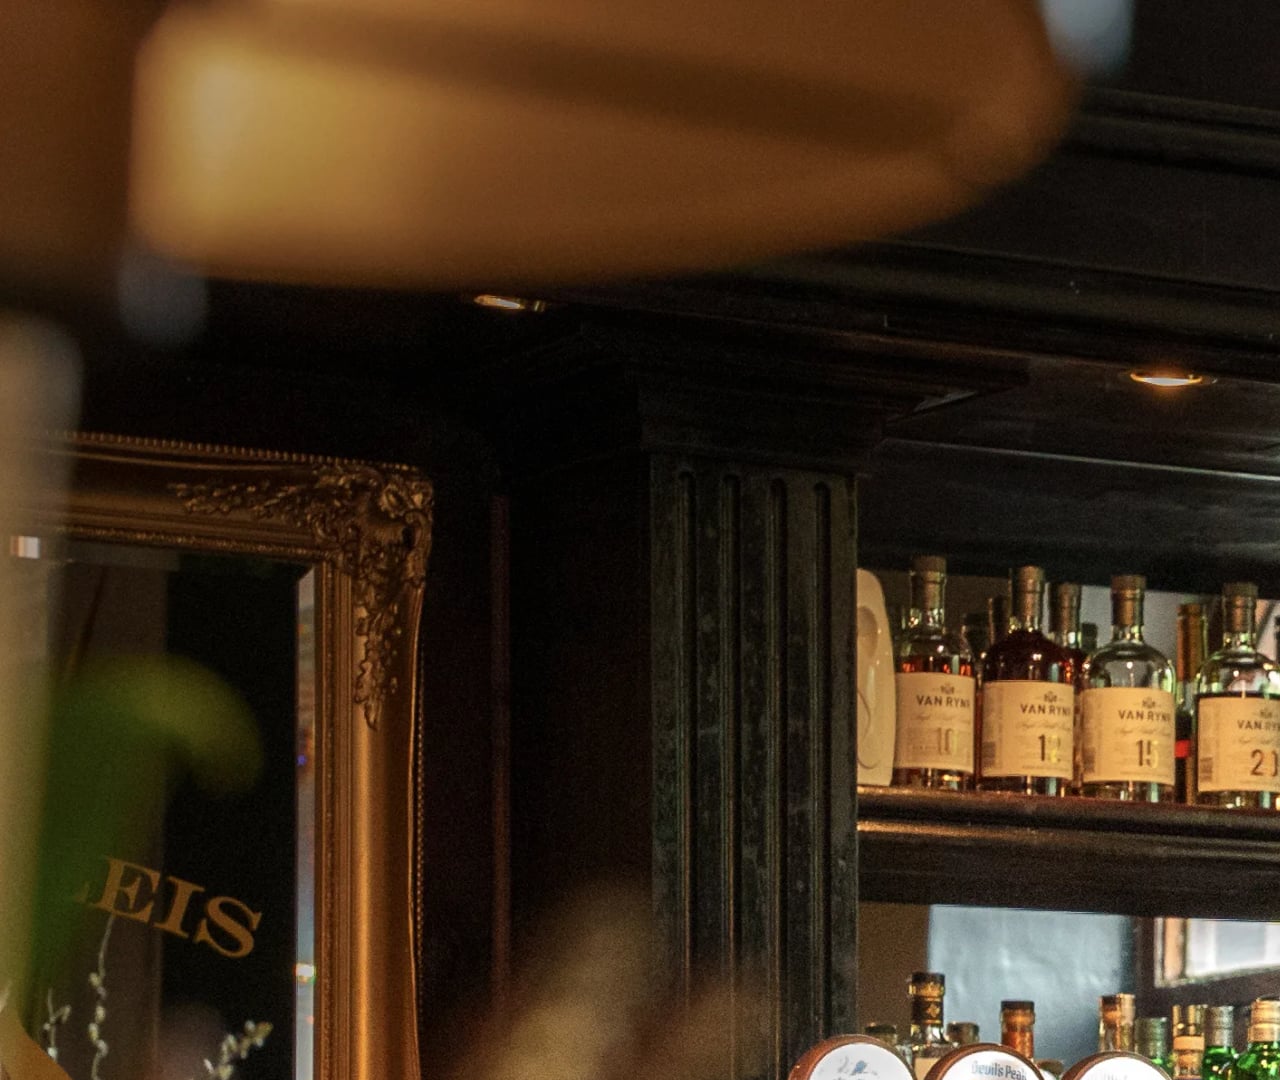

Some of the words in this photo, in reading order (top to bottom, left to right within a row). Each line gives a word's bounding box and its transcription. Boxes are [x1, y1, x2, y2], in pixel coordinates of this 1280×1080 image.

[916, 694, 943, 706] VAN
[1020, 703, 1046, 714] VAN
[1118, 709, 1144, 720] VAN
[1237, 719, 1262, 731] VAN
[1136, 740, 1159, 769] 15
